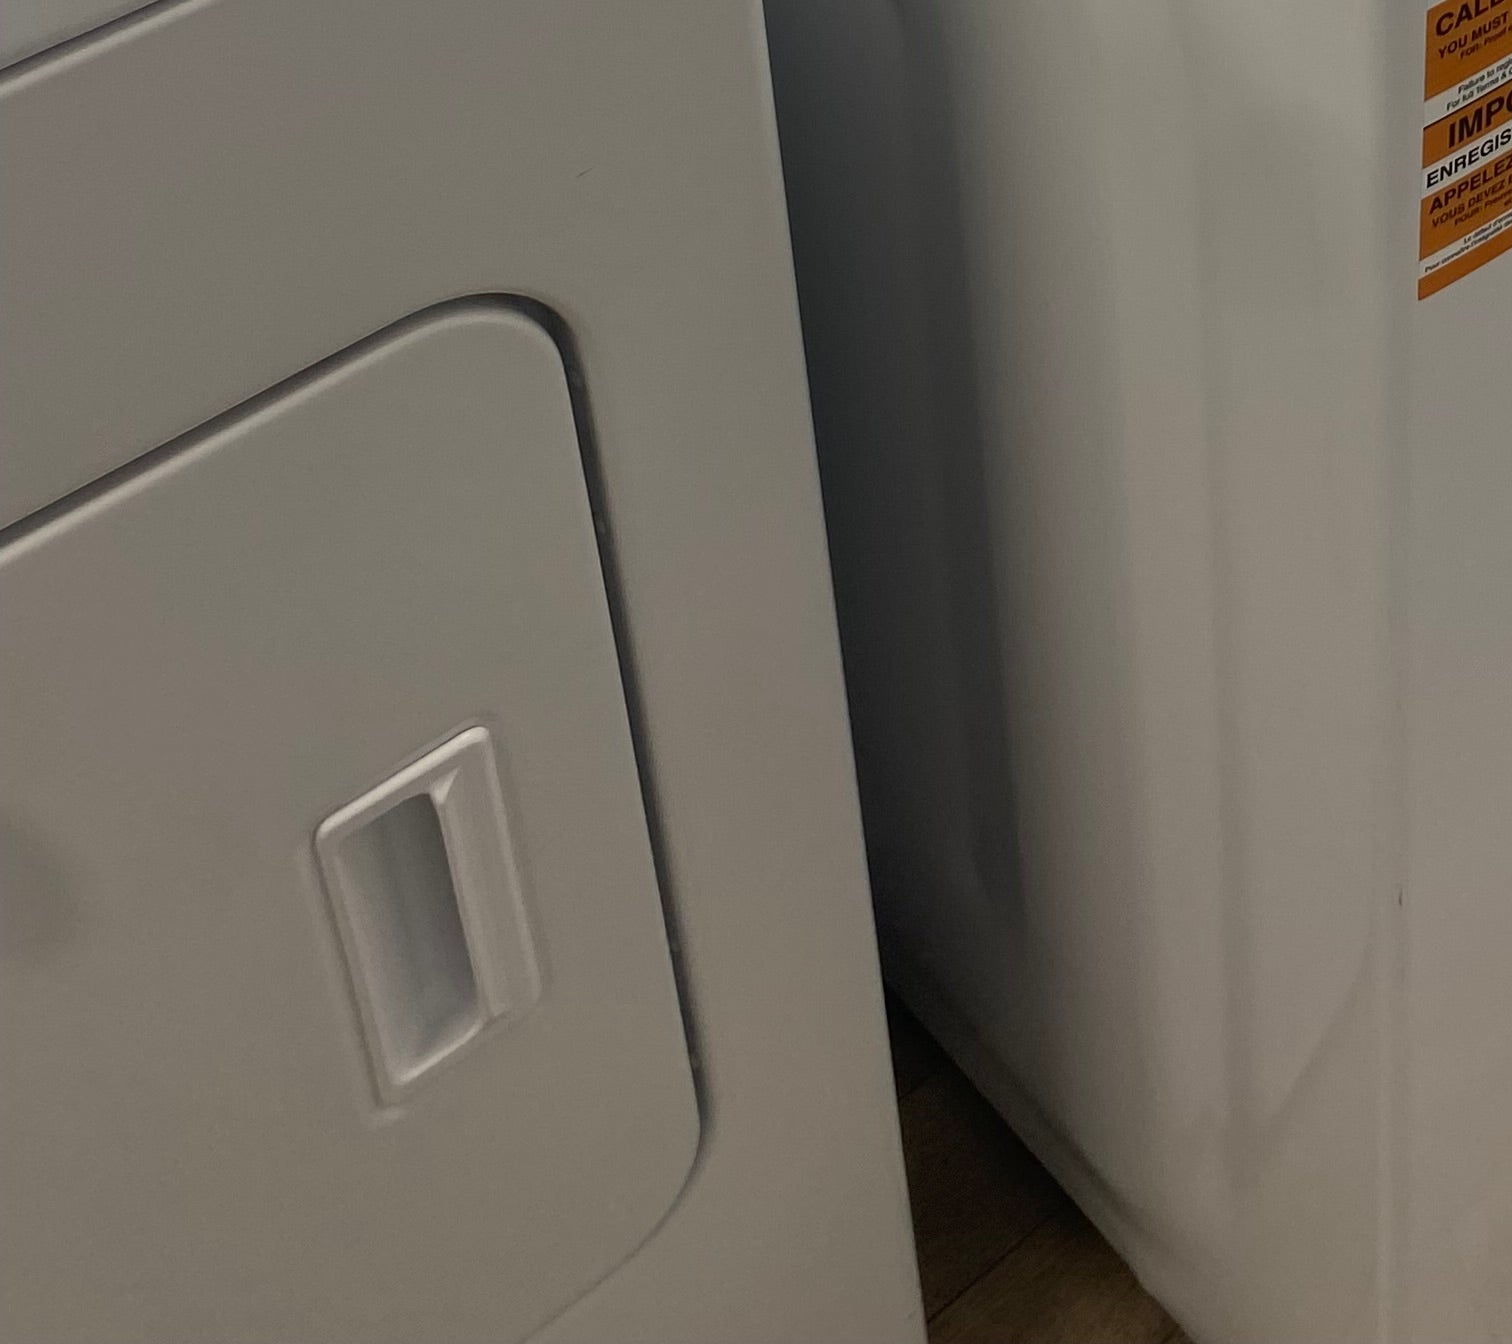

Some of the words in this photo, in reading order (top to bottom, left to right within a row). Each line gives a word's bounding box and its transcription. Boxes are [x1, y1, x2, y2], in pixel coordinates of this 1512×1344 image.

[1437, 33, 1467, 62] YOU
[1471, 9, 1508, 42] MUST
[1432, 200, 1464, 230] VOUS
[1468, 177, 1505, 209] DEVEZ
